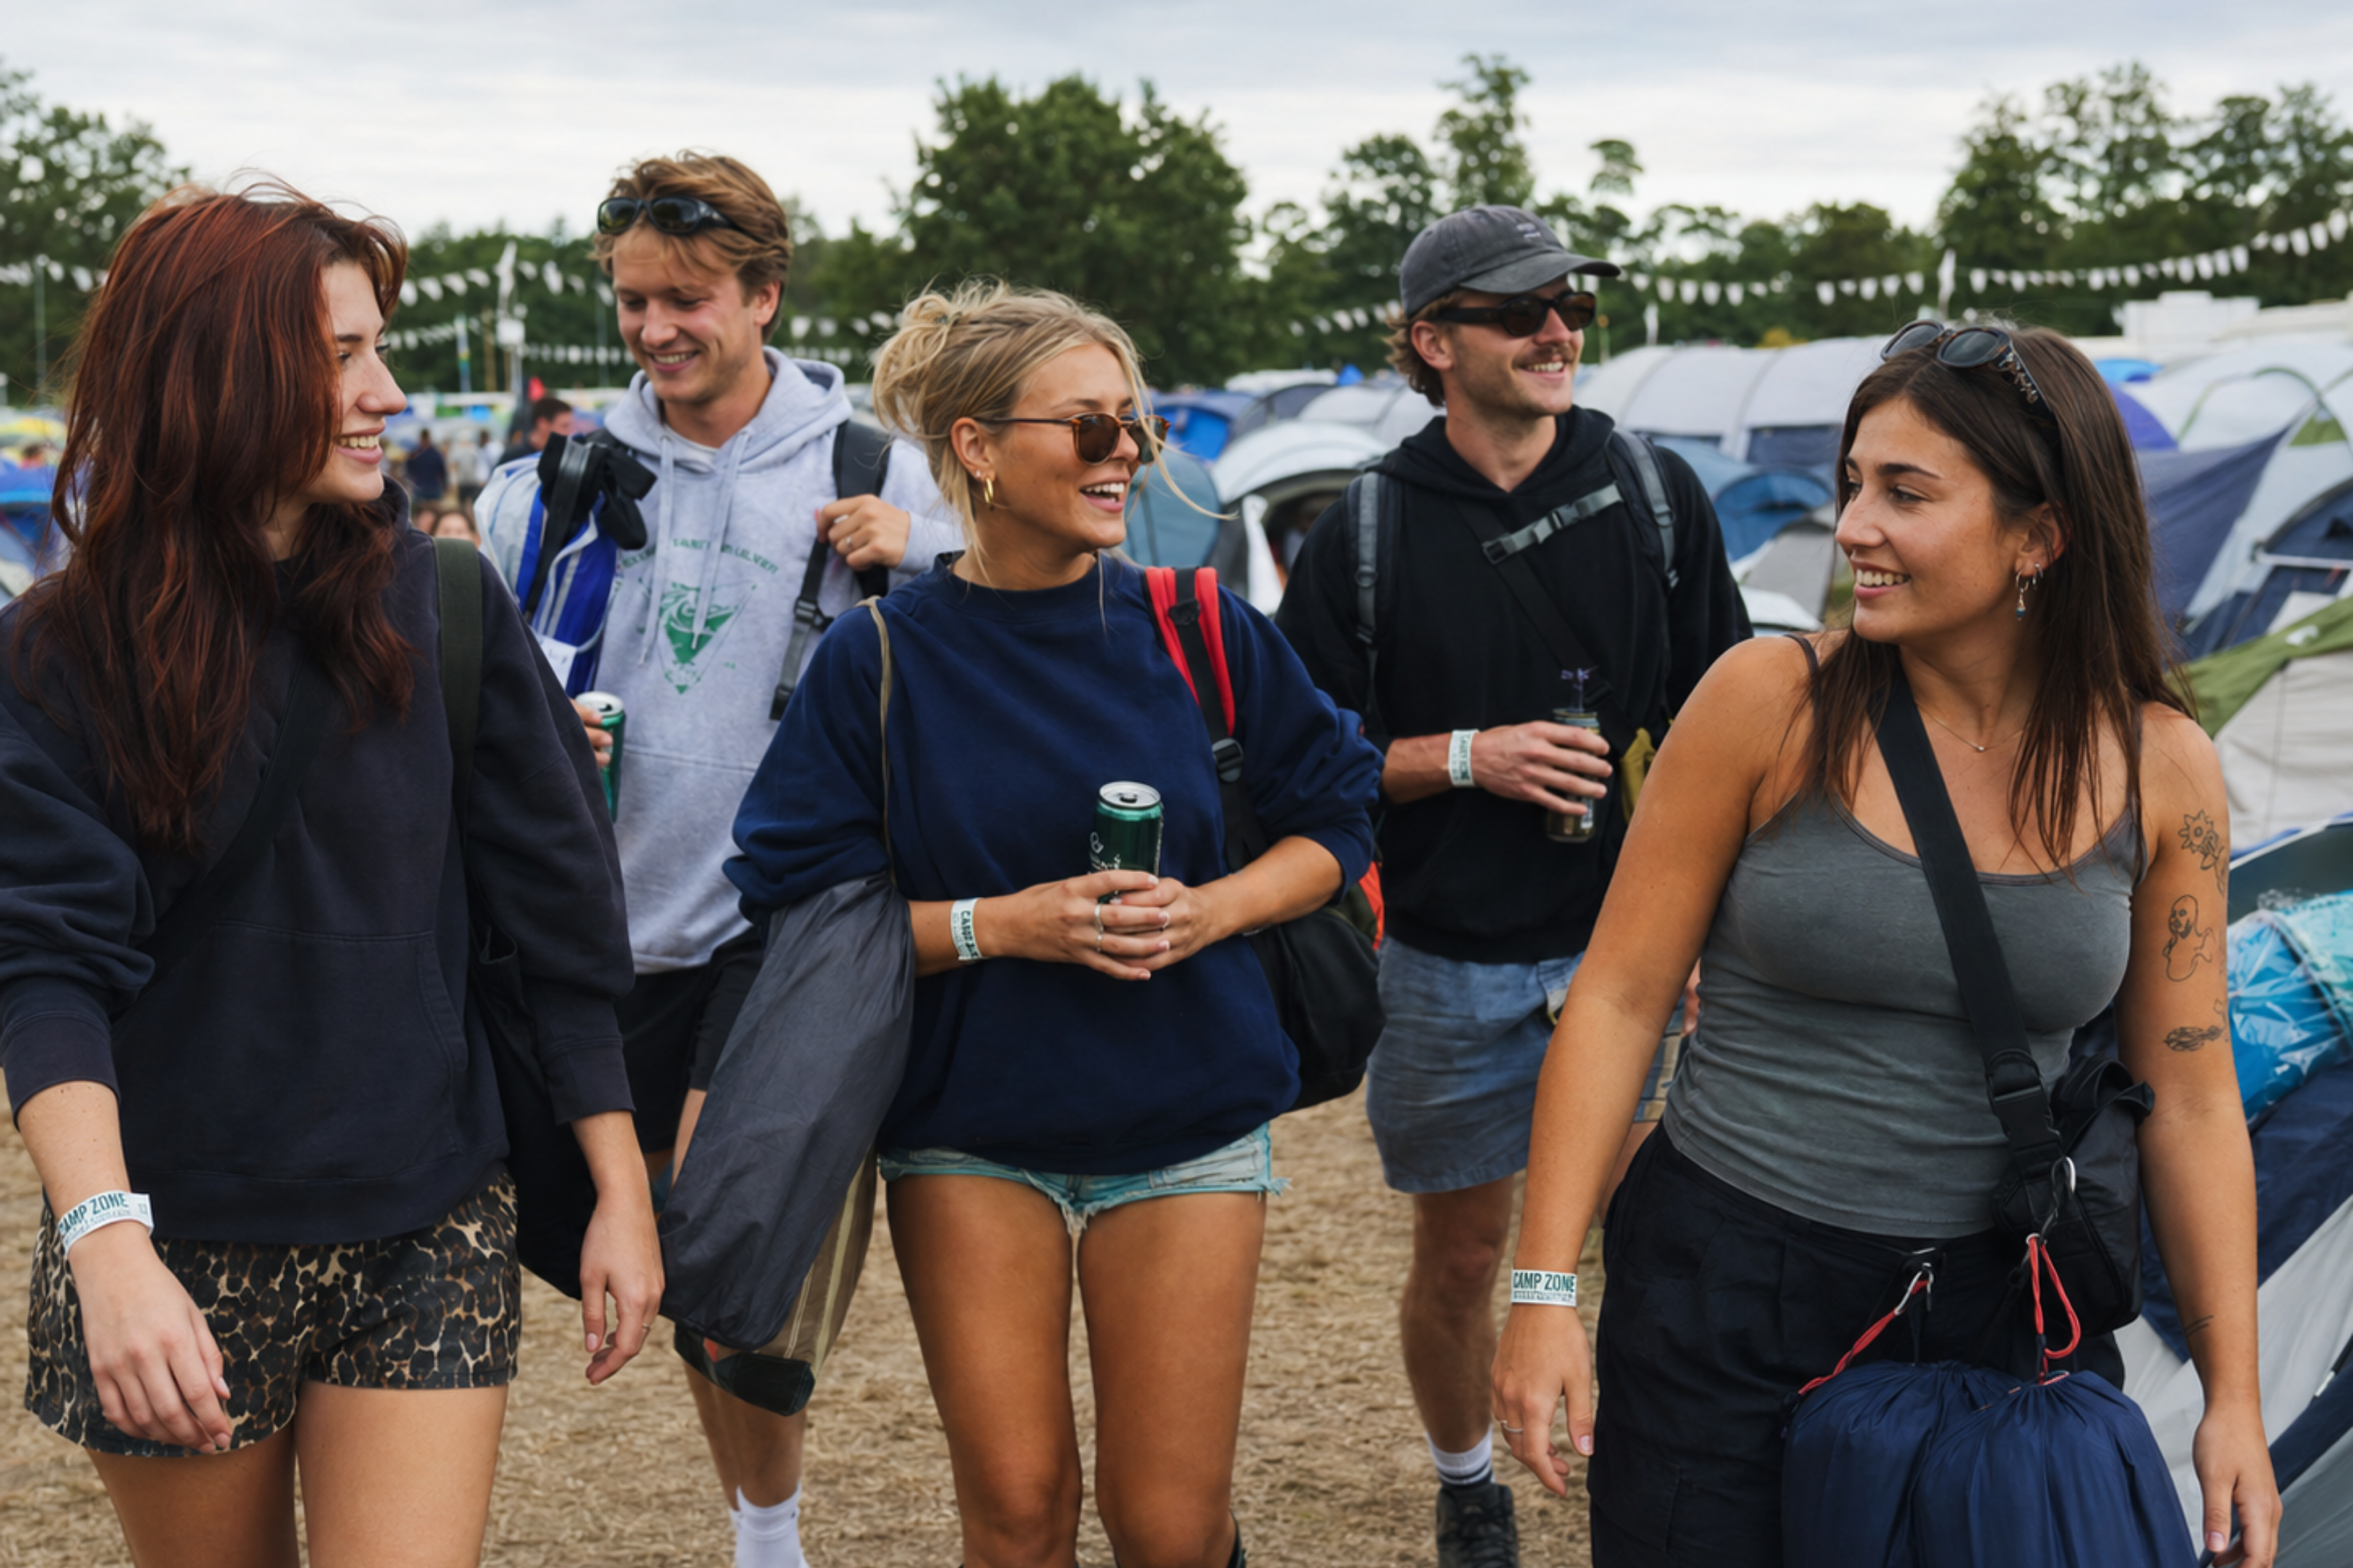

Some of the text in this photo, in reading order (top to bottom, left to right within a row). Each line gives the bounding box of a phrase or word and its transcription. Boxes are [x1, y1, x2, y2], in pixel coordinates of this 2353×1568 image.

[90, 1192, 129, 1215] ZONE
[1513, 1271, 1575, 1292] CAMP ZONE
